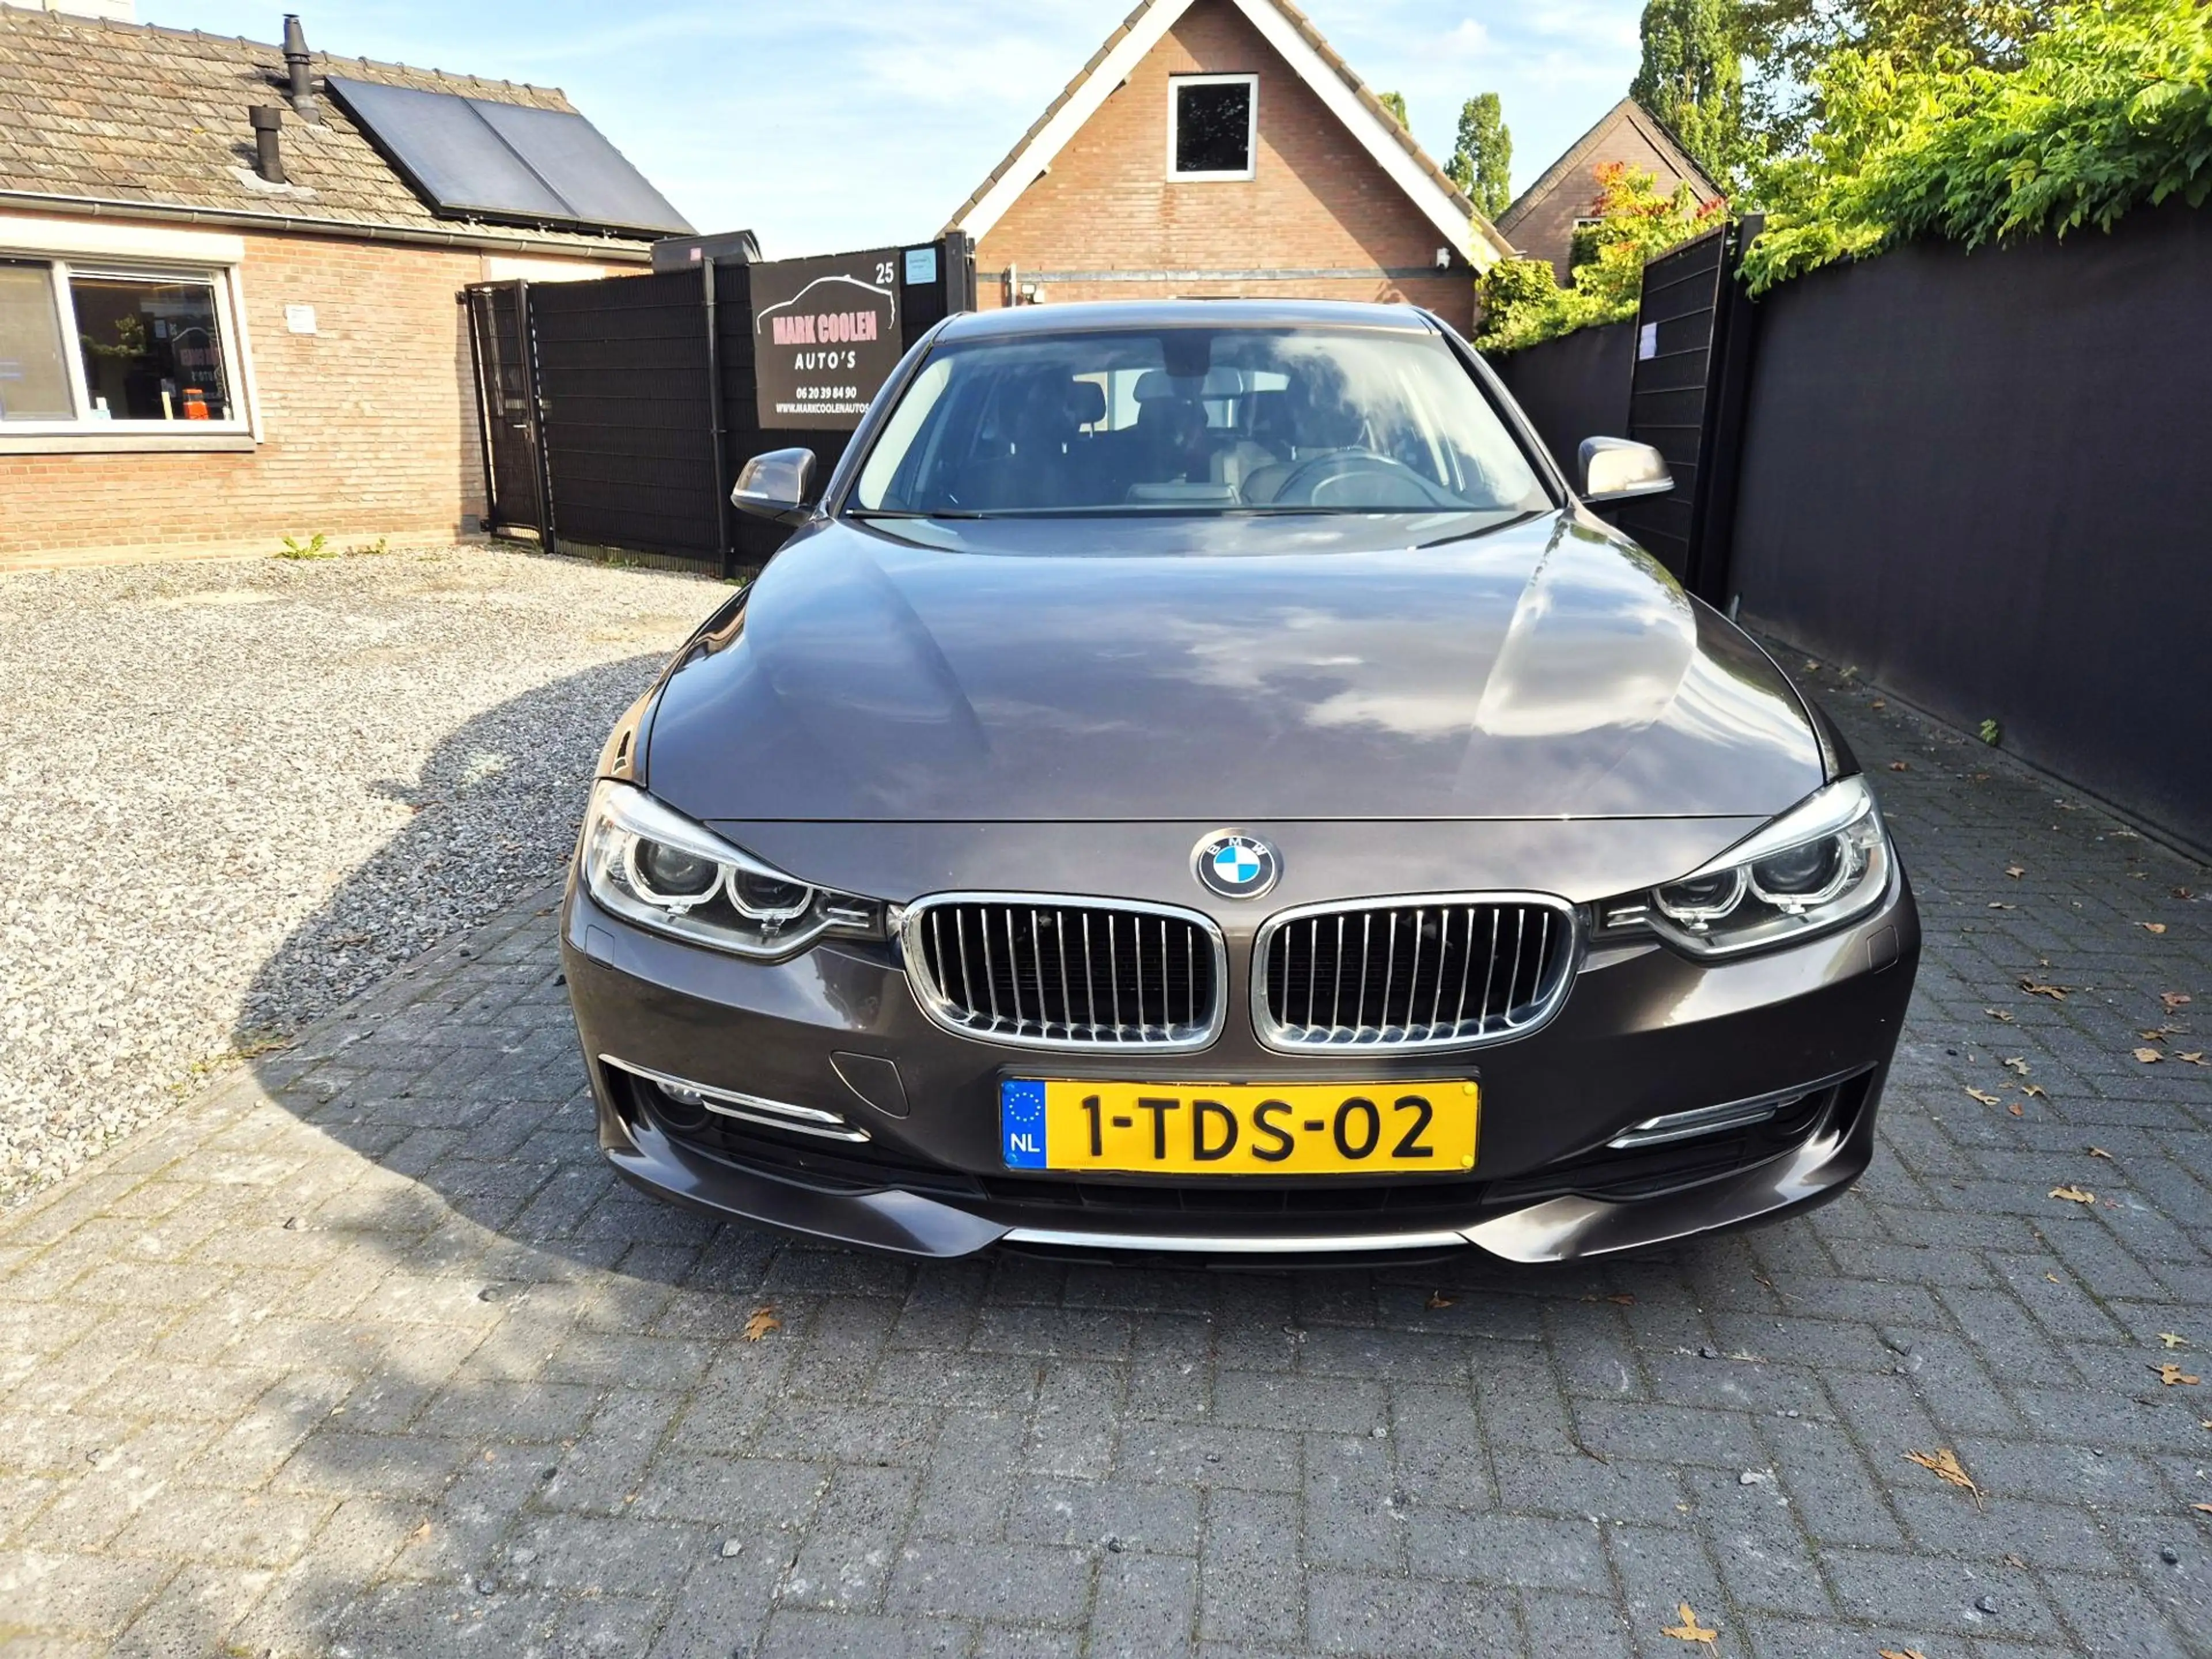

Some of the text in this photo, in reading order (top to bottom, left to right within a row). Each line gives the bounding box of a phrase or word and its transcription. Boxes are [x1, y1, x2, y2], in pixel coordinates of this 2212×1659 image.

[876, 262, 894, 284] 25
[772, 311, 877, 345] MARK COOLEN
[794, 350, 856, 370] AUTO'S
[796, 386, 857, 399] 06 20 39 84 90
[1206, 836, 1268, 856] BMW
[1010, 1094, 1435, 1162] NL 1-TDS-02
